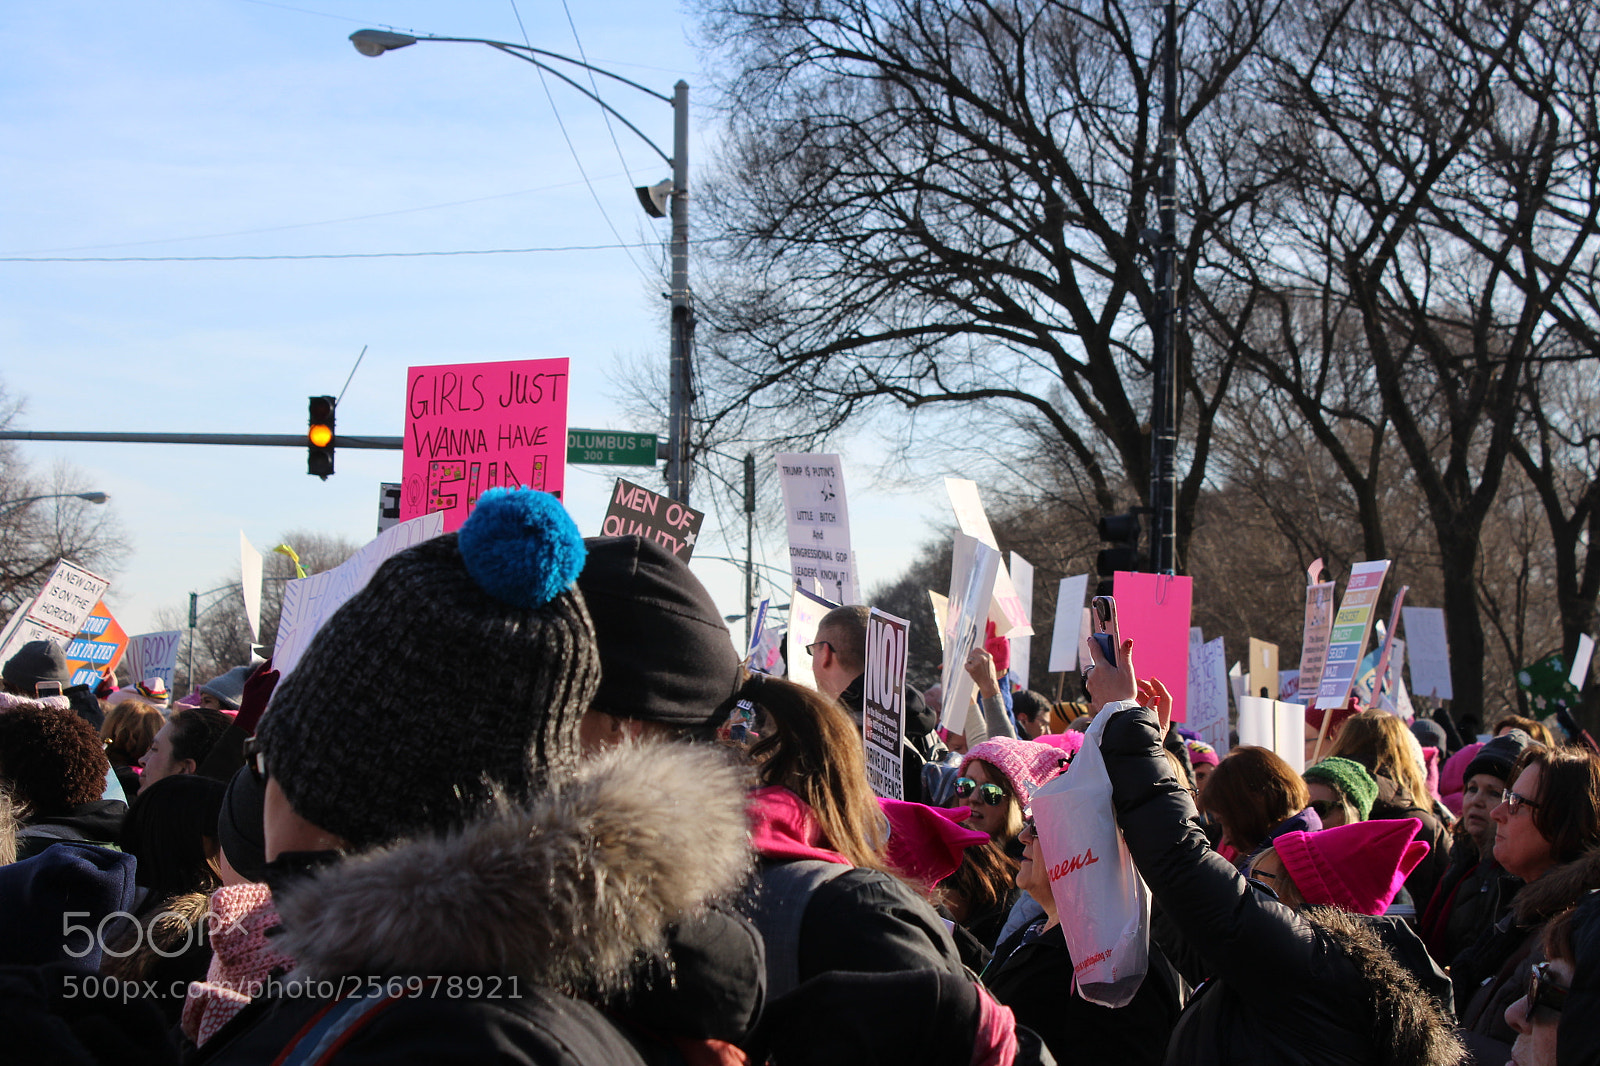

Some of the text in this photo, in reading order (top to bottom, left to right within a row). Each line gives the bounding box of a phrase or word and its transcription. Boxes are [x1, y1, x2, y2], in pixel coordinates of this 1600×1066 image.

[410, 371, 566, 419] GIRLS JUST
[412, 422, 549, 459] WANNA HAVE
[567, 434, 653, 450] OLUMBUS DR
[584, 451, 615, 461] 300 E
[782, 466, 835, 478] TRUMP IS PUTIN'S
[615, 482, 695, 530] MEN OF
[796, 510, 836, 523] LITTLE BITCH
[603, 515, 686, 556] QUALITY
[812, 530, 824, 540] And
[789, 546, 848, 563] CONGRESSIONAL GOP
[57, 568, 102, 595] A NEW DAY
[794, 566, 818, 578] LEADERS
[820, 568, 838, 581] KNOW
[1349, 575, 1367, 588] SUPER
[49, 585, 90, 610] IS ON THE
[41, 602, 78, 624] HORIZON
[82, 616, 109, 634] STORY
[29, 628, 43, 640] WE
[1333, 628, 1353, 641] RACIST
[79, 643, 96, 660] ITS
[93, 645, 117, 660] EYES
[144, 635, 177, 667] BODY
[1328, 647, 1348, 659] SEXIST
[867, 618, 904, 714] NO!
[1325, 665, 1339, 677] NAZI
[72, 670, 88, 686] ON
[1320, 684, 1337, 696] POTUS
[865, 745, 902, 782] DRIVE OUT THE
[1047, 847, 1099, 882] reens
